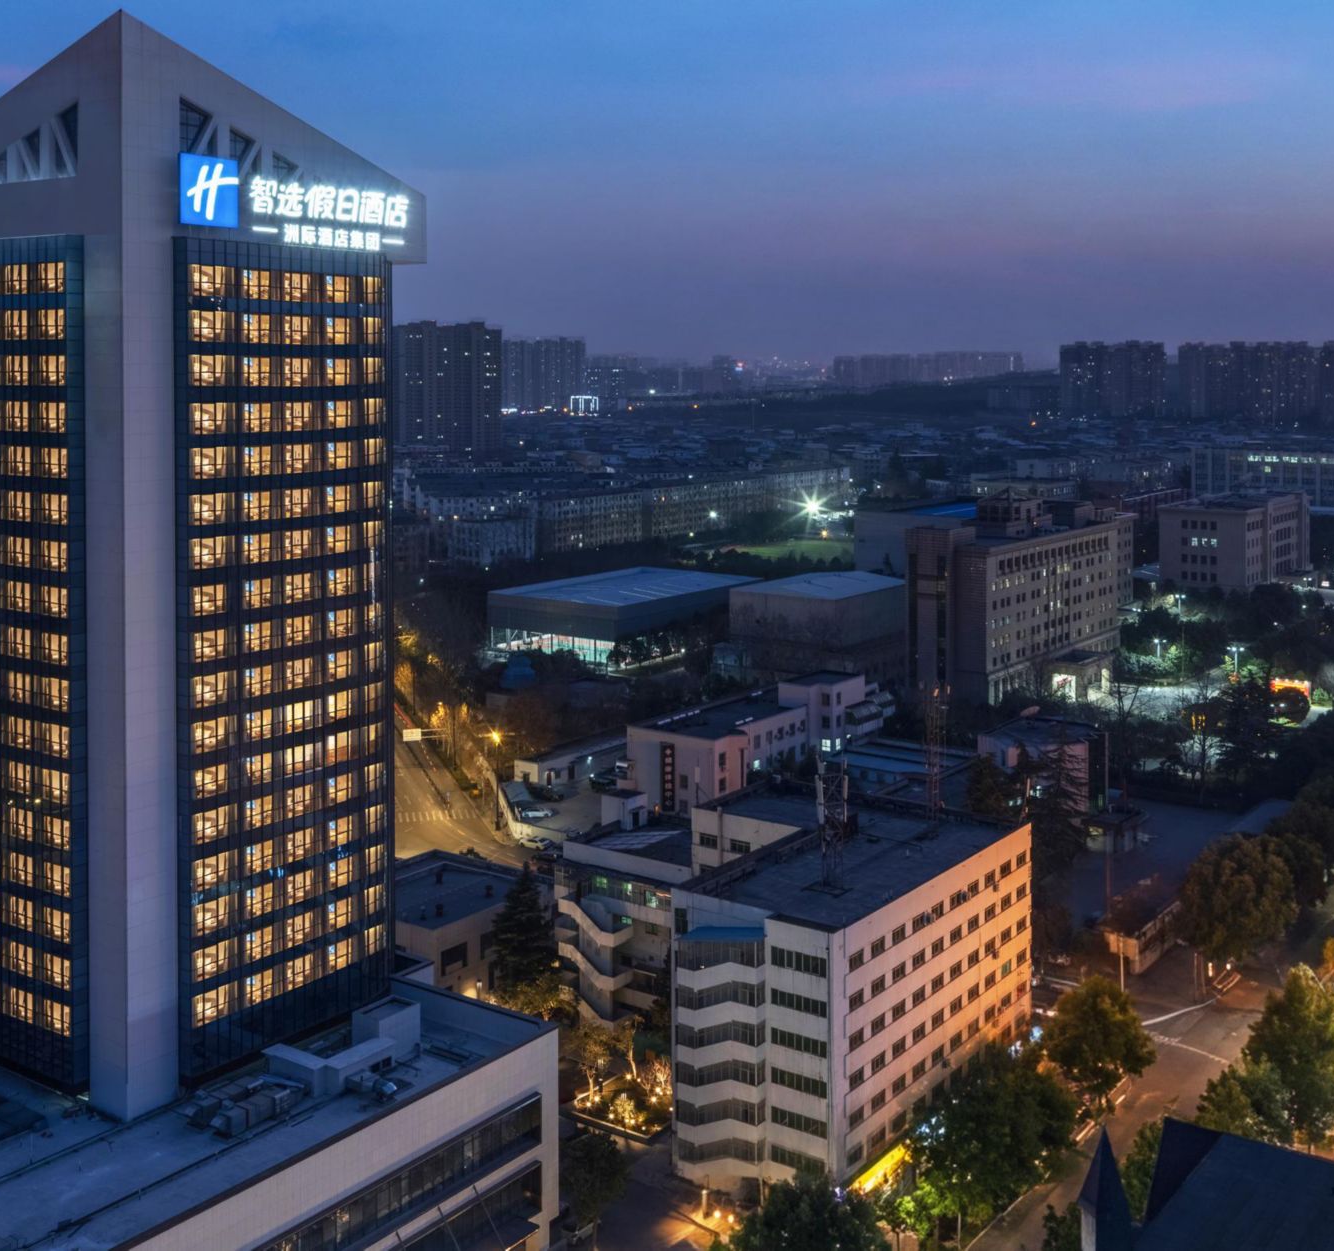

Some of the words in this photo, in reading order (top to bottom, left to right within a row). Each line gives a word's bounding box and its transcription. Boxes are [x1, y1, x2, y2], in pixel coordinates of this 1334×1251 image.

[187, 163, 239, 221] H
[250, 176, 409, 228] 智选假日酒店
[284, 224, 380, 251] 洲际酒店集团
